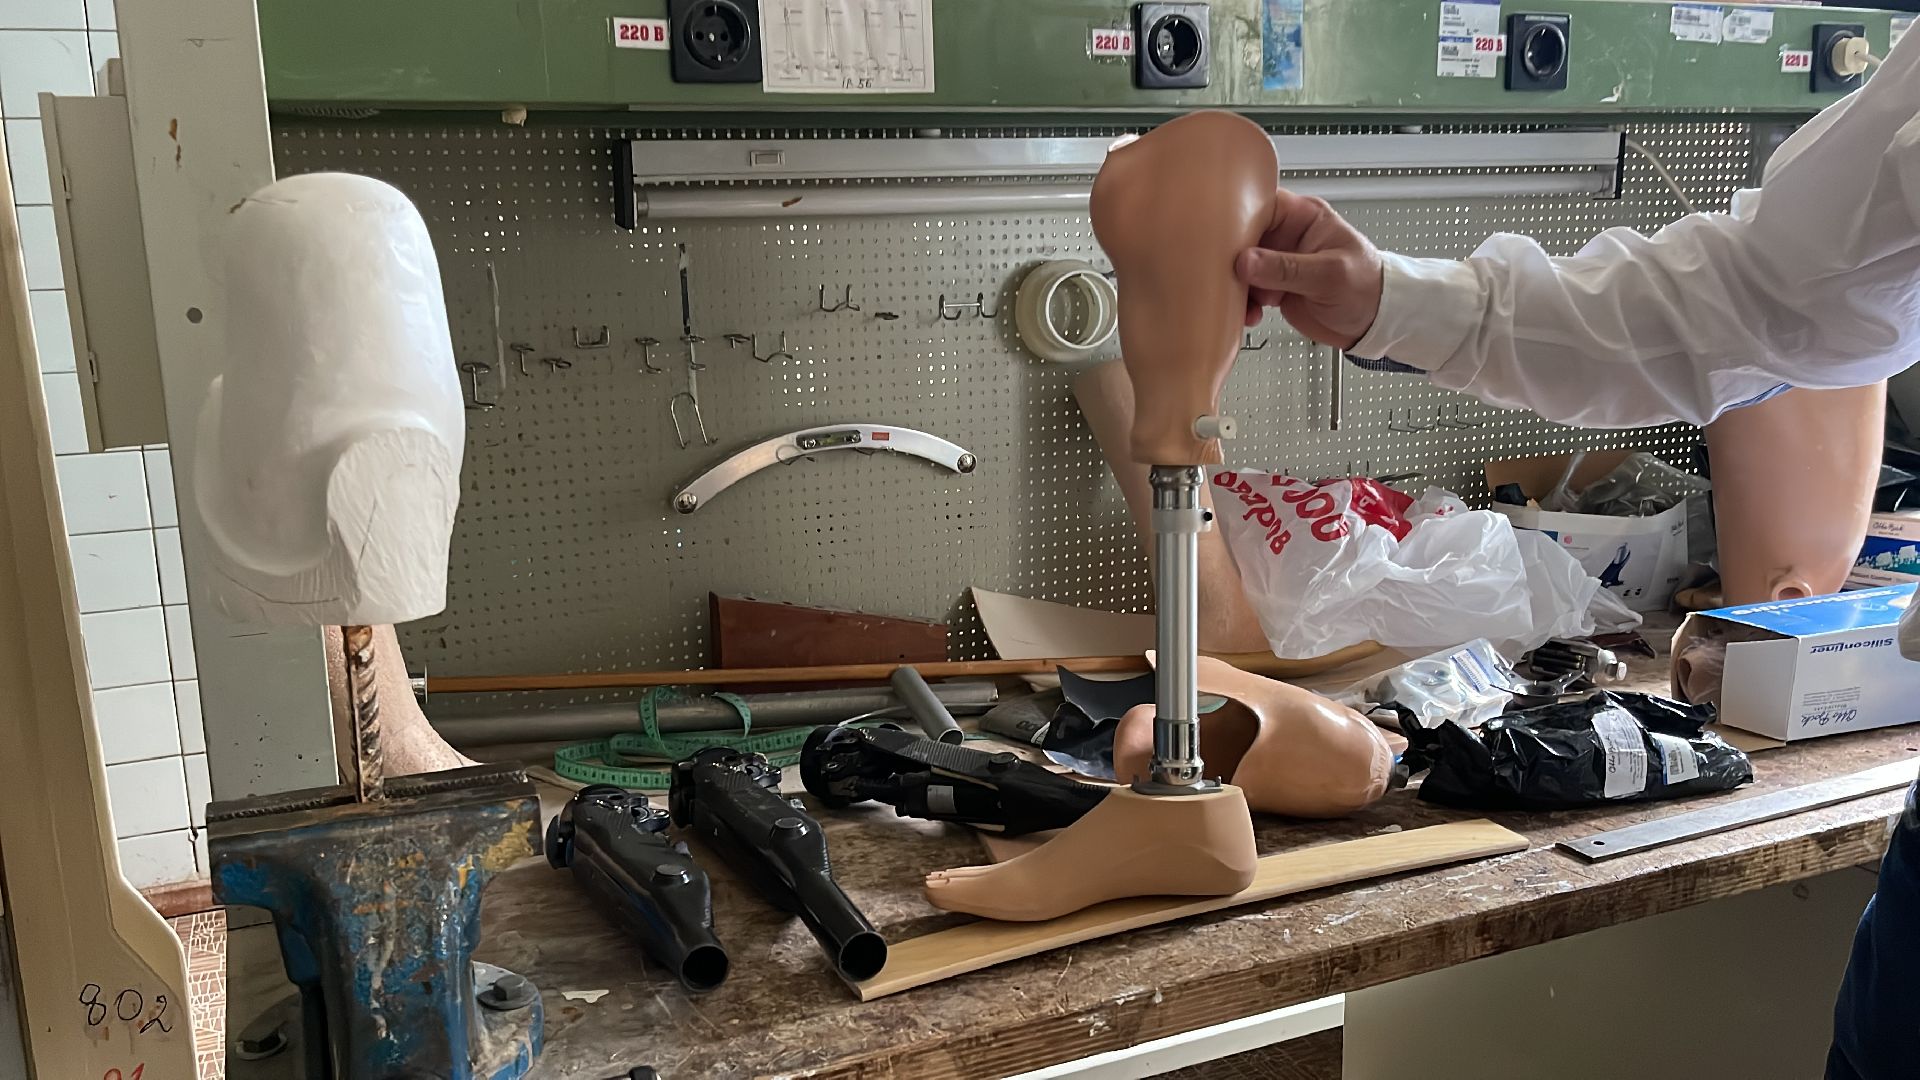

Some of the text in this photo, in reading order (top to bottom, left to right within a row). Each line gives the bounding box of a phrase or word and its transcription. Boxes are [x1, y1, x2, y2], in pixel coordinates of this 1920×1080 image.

[620, 24, 649, 41] 220
[1095, 35, 1119, 50] 220
[1475, 37, 1494, 51] 220
[1832, 709, 1857, 723] Otto
[79, 983, 173, 1034] 802
